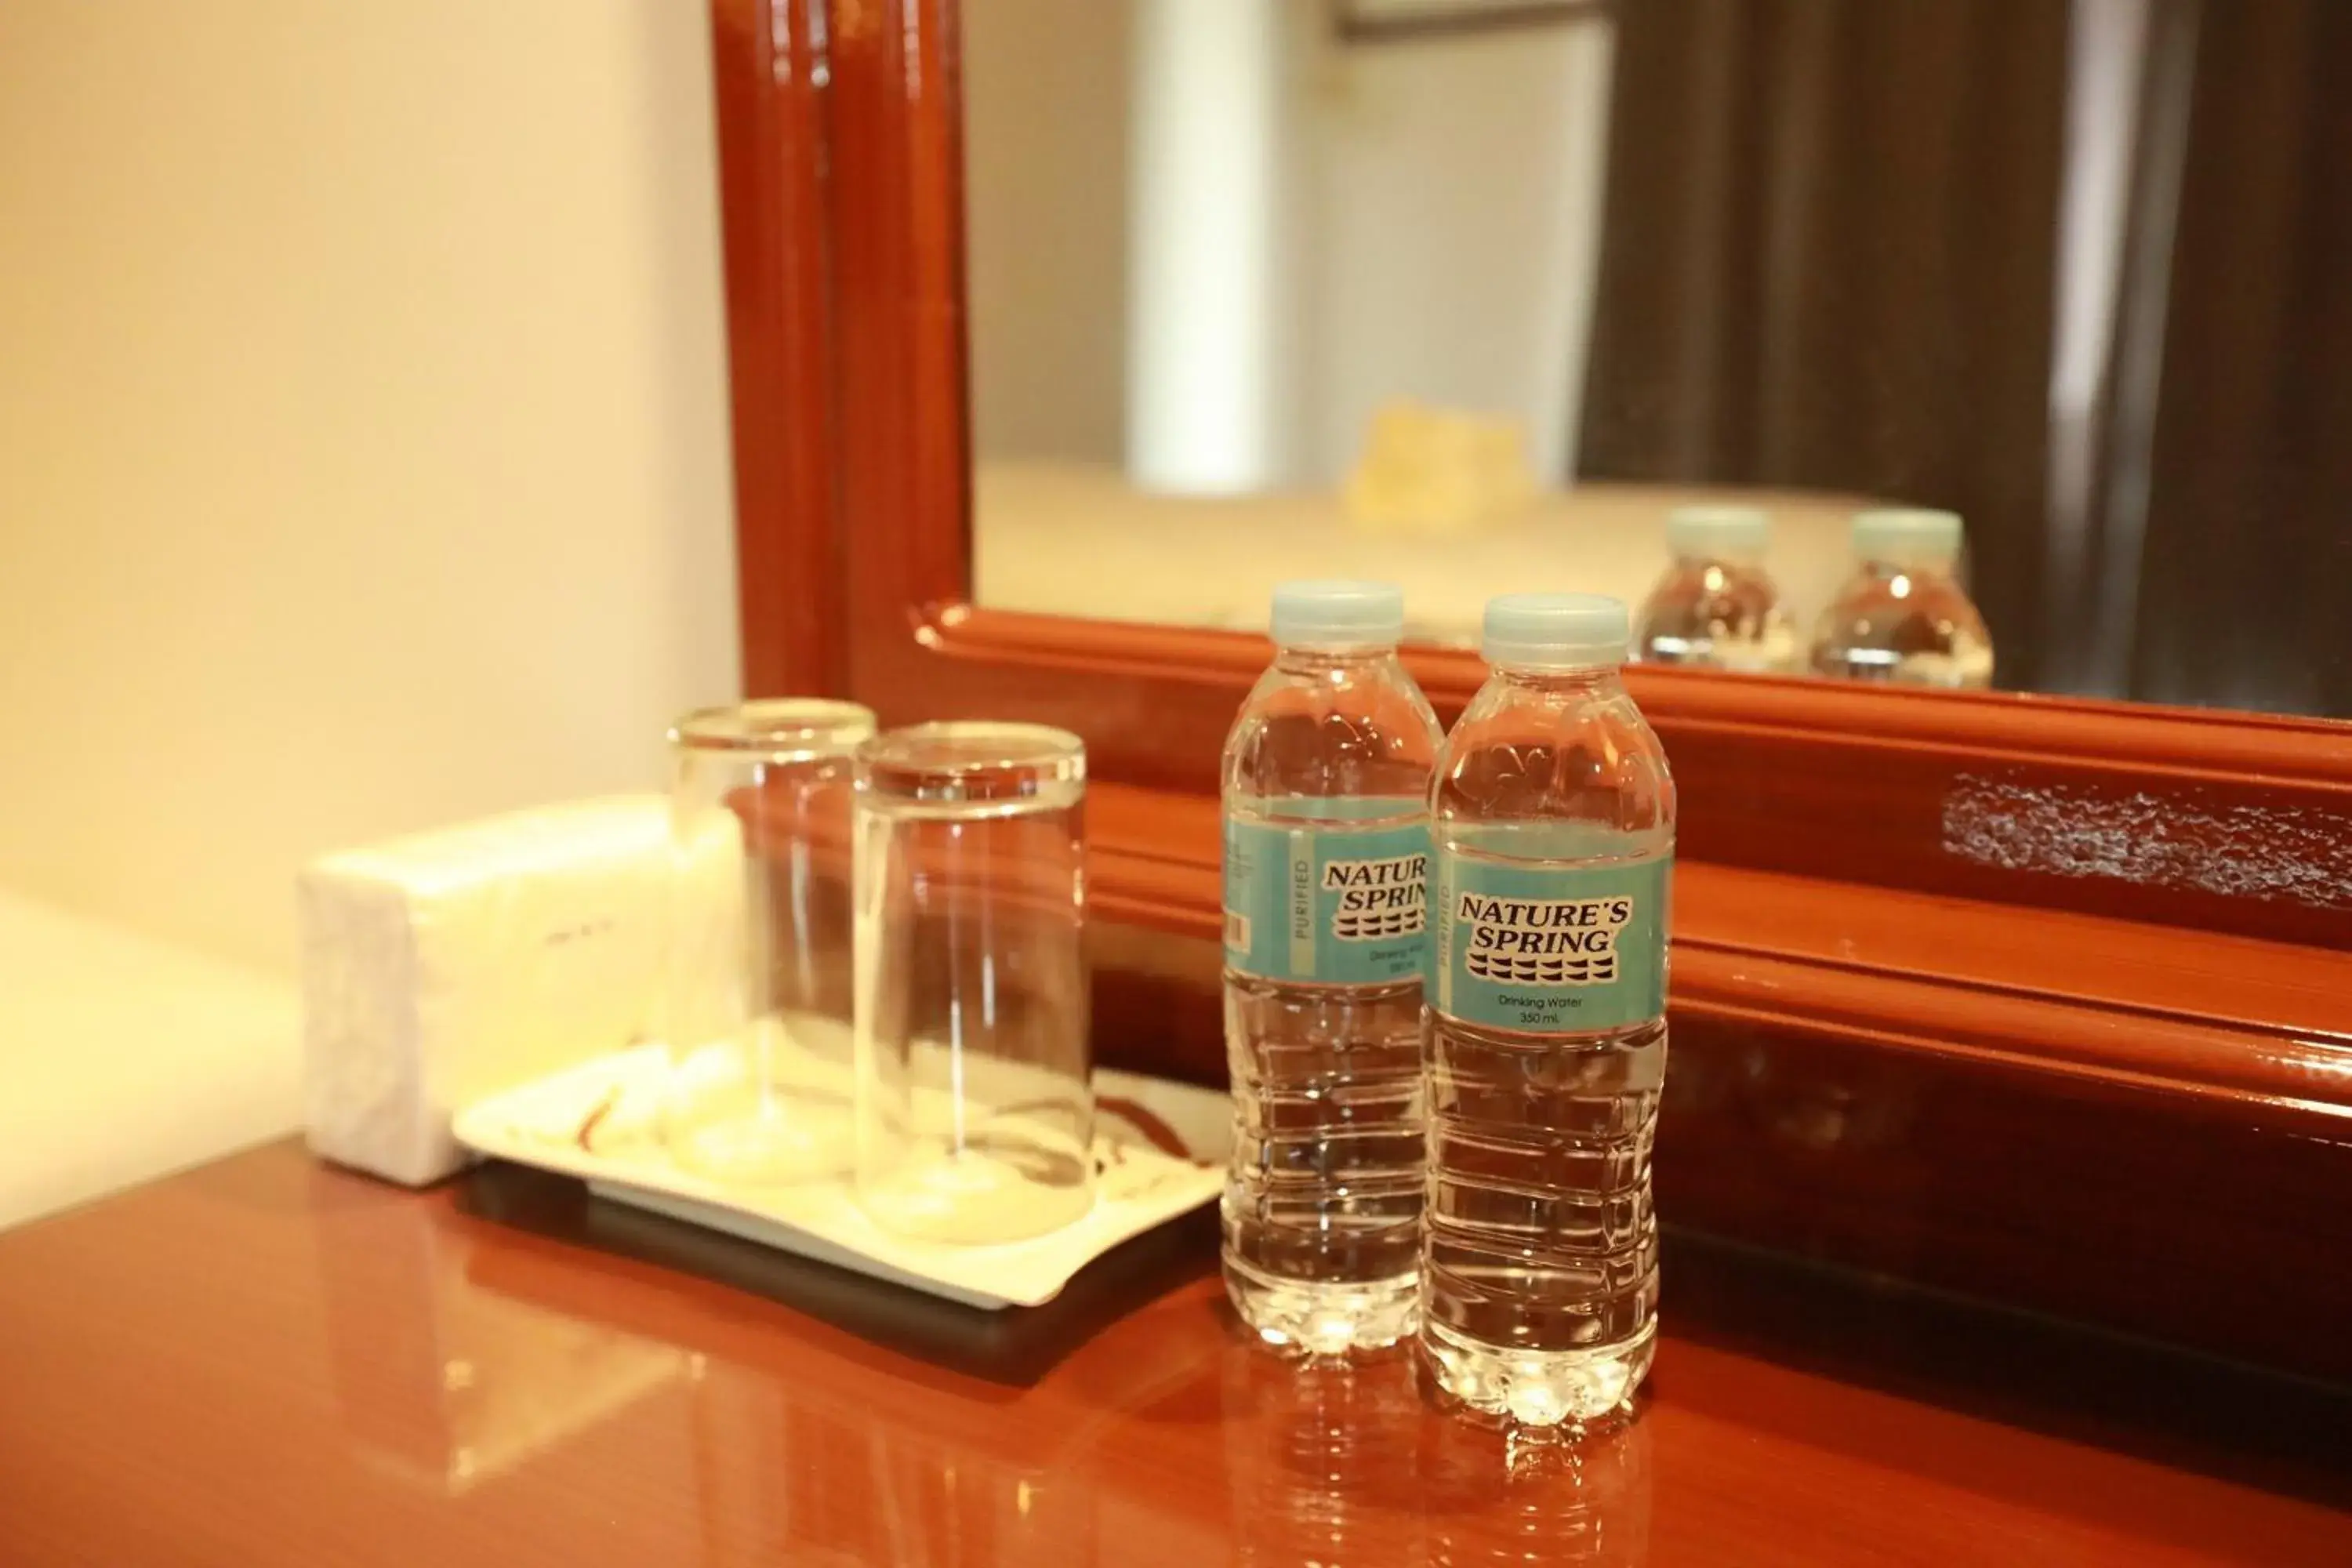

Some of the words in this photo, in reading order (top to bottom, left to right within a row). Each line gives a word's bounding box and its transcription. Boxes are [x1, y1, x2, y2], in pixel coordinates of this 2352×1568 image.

[1326, 856, 1426, 887] NATUR
[1294, 860, 1309, 939] PURIFIED
[1461, 896, 1629, 927] NATURE'S
[1474, 926, 1609, 954] SPRING
[1497, 994, 1545, 1011] Drinking
[1547, 996, 1583, 1009] Water
[1520, 1012, 1541, 1024] 350
